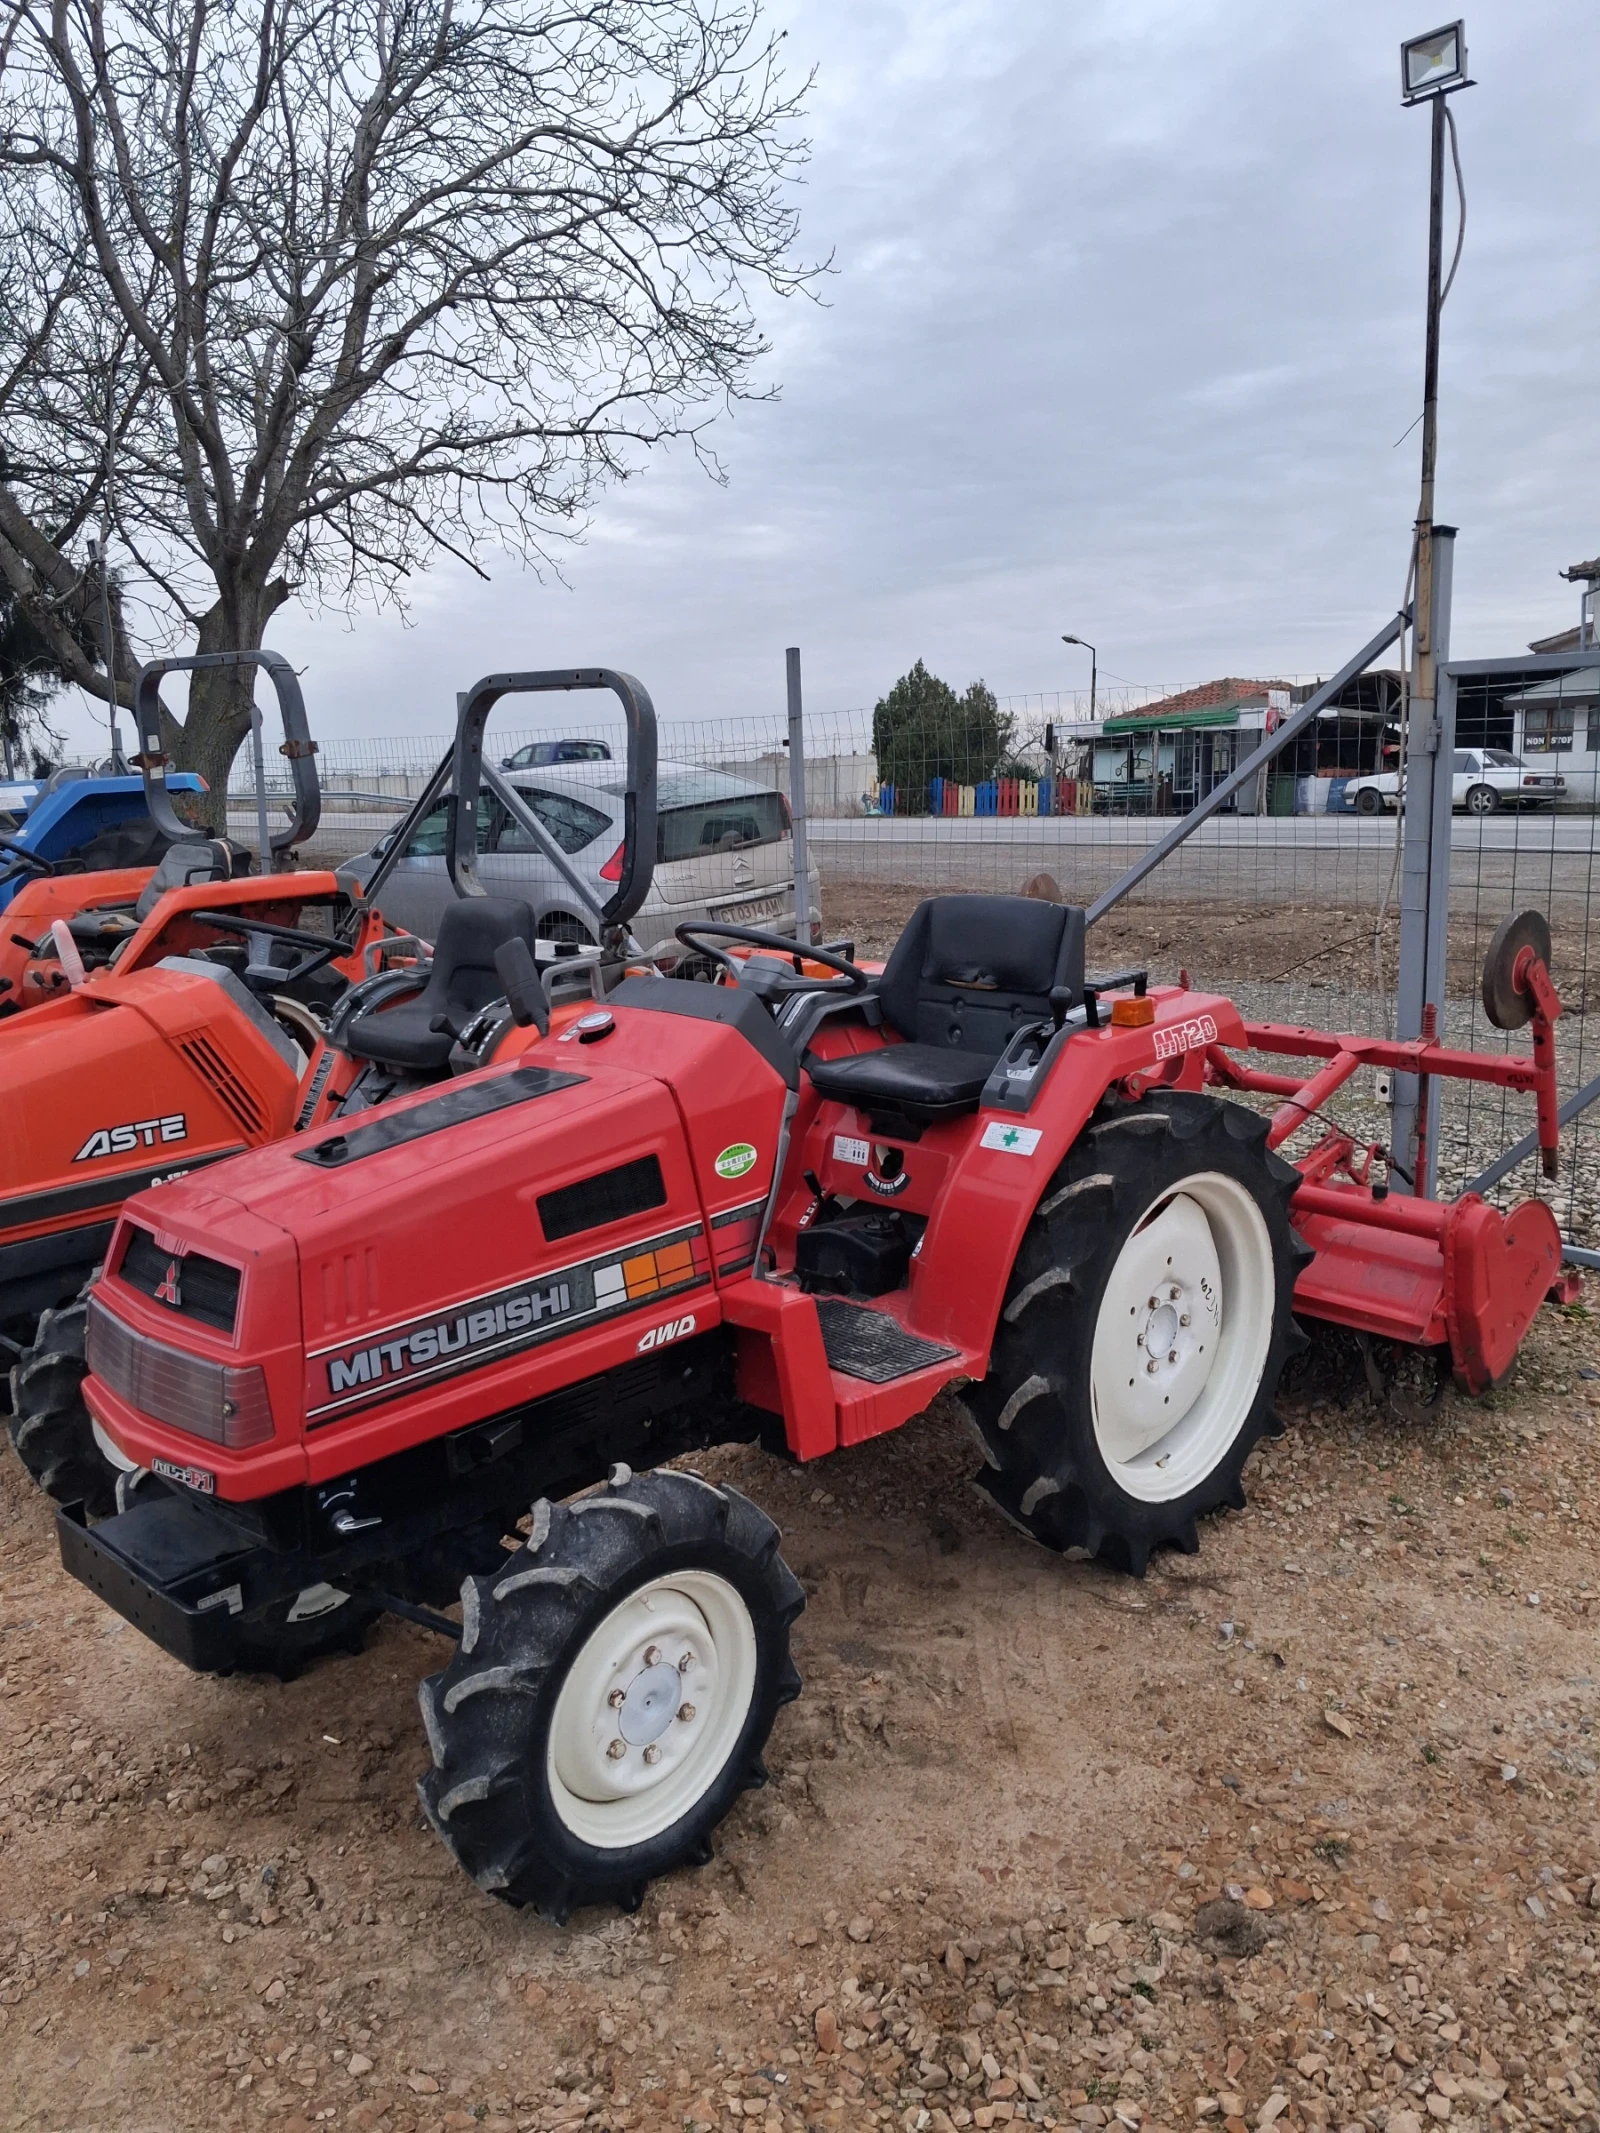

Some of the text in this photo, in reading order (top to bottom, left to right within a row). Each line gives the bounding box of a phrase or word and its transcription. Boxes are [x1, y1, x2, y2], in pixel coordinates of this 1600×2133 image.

[1526, 736, 1572, 745] NON STOP
[738, 903, 764, 920] 0314
[765, 899, 779, 915] AM
[1153, 1015, 1217, 1060] MT20
[72, 1113, 187, 1162] ASTE
[330, 1284, 571, 1391] MITSUBISHI
